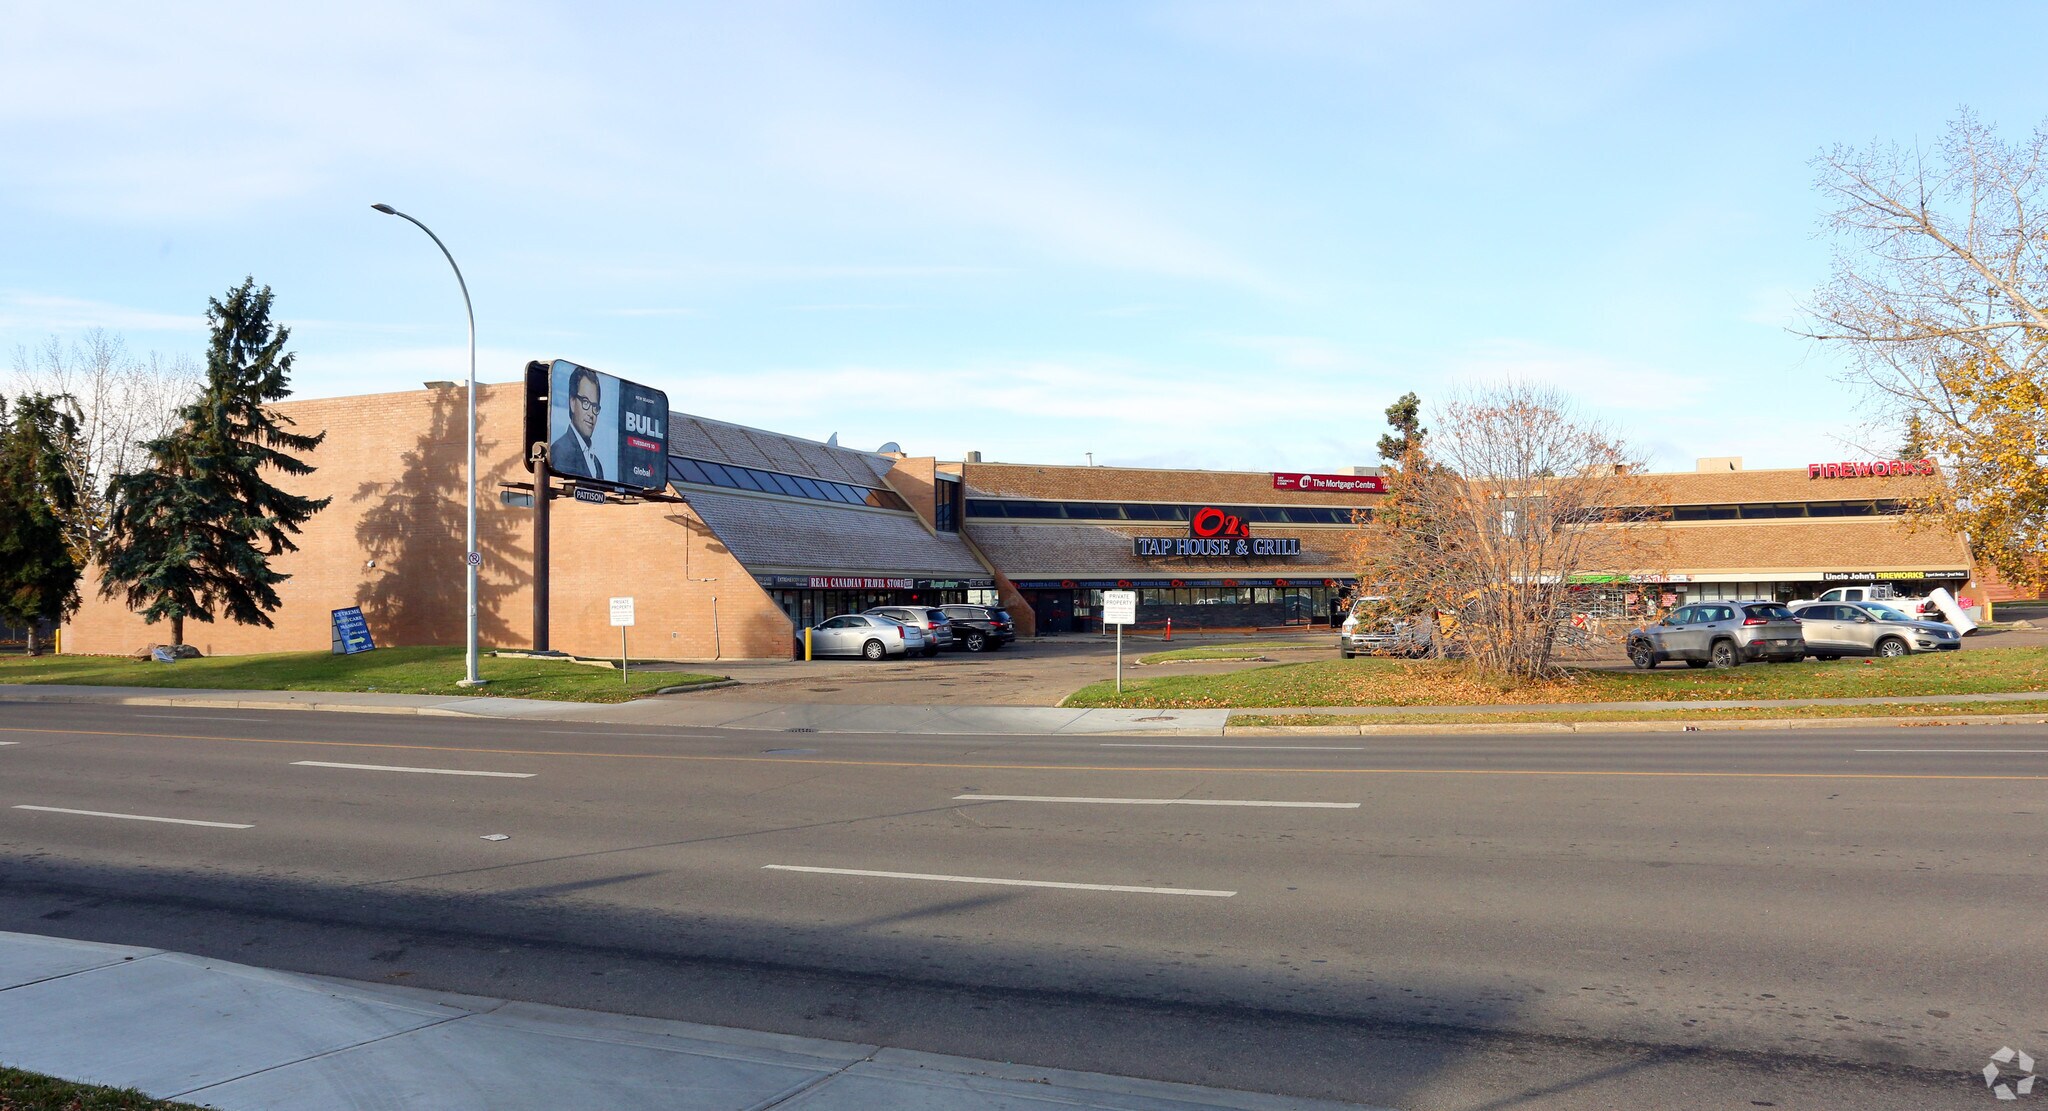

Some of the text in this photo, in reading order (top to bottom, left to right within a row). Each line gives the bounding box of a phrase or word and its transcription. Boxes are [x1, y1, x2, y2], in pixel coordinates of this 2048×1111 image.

[626, 411, 663, 439] BULL
[633, 439, 650, 448] TUESDAYS
[633, 466, 651, 477] Global
[1808, 459, 1932, 477] FIREWORKS
[1313, 479, 1325, 487] The
[1326, 480, 1354, 490] Mortgage
[1355, 480, 1376, 489] Centre
[576, 490, 604, 502] PATTISON
[1193, 507, 1249, 537] O2's
[1138, 538, 1300, 556] TAP HOUSE & GRILL
[1850, 572, 1875, 580] John's
[811, 577, 828, 588] REAL
[831, 578, 862, 588] CANADIAN
[864, 578, 884, 588] TRAVEL
[887, 578, 904, 588] STORE
[334, 609, 360, 617] EXTREME
